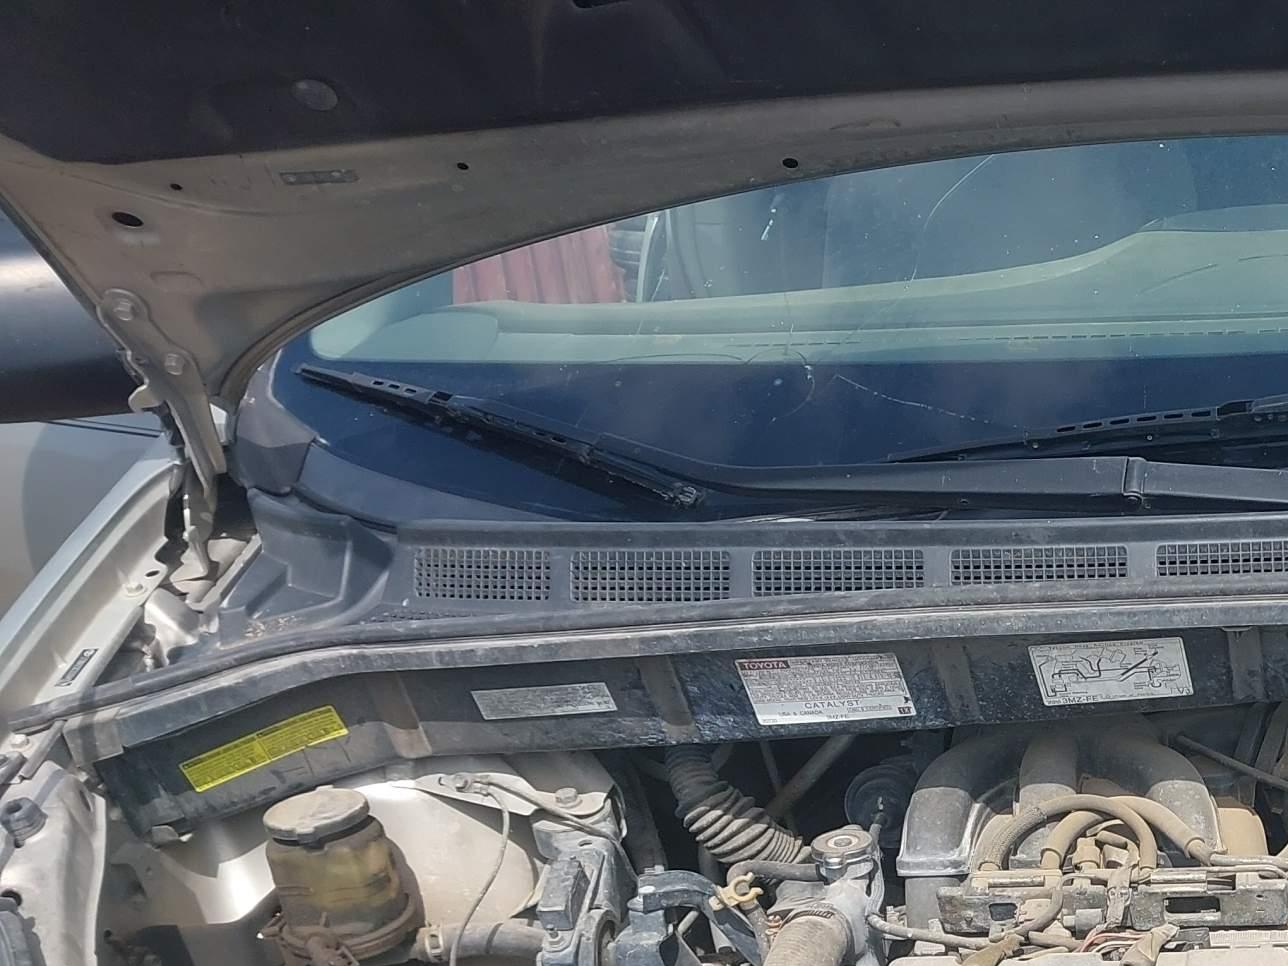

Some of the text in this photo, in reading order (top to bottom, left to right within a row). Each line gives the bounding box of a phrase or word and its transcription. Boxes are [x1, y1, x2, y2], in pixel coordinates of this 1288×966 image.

[743, 661, 787, 670] TOYOTA
[1062, 695, 1100, 704] 3MZ-FE
[804, 699, 861, 710] CATALYST
